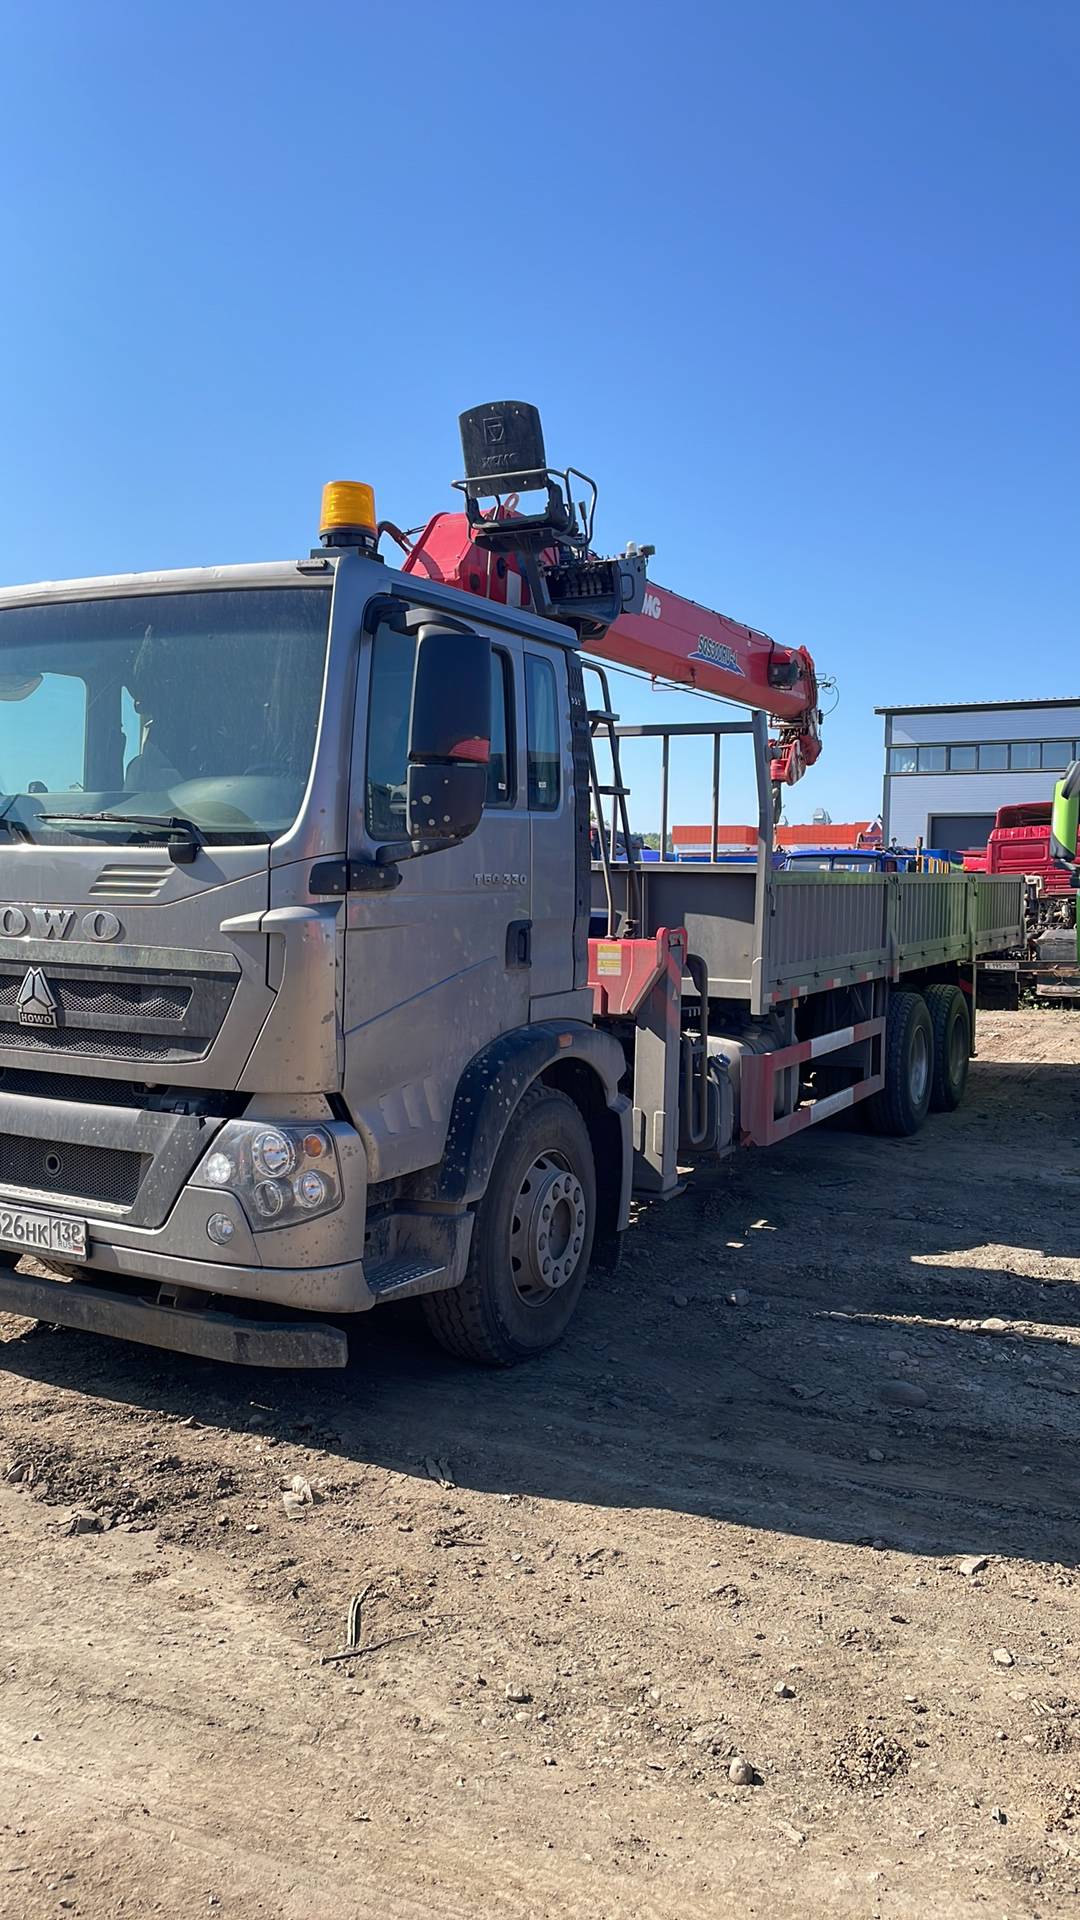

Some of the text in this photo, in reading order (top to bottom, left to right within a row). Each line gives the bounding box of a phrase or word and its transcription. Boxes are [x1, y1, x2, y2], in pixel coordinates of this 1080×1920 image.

[503, 873, 527, 885] 330
[21, 1013, 52, 1024] HOWO
[0, 1212, 49, 1246] 26HK
[57, 1240, 73, 1250] RUS
